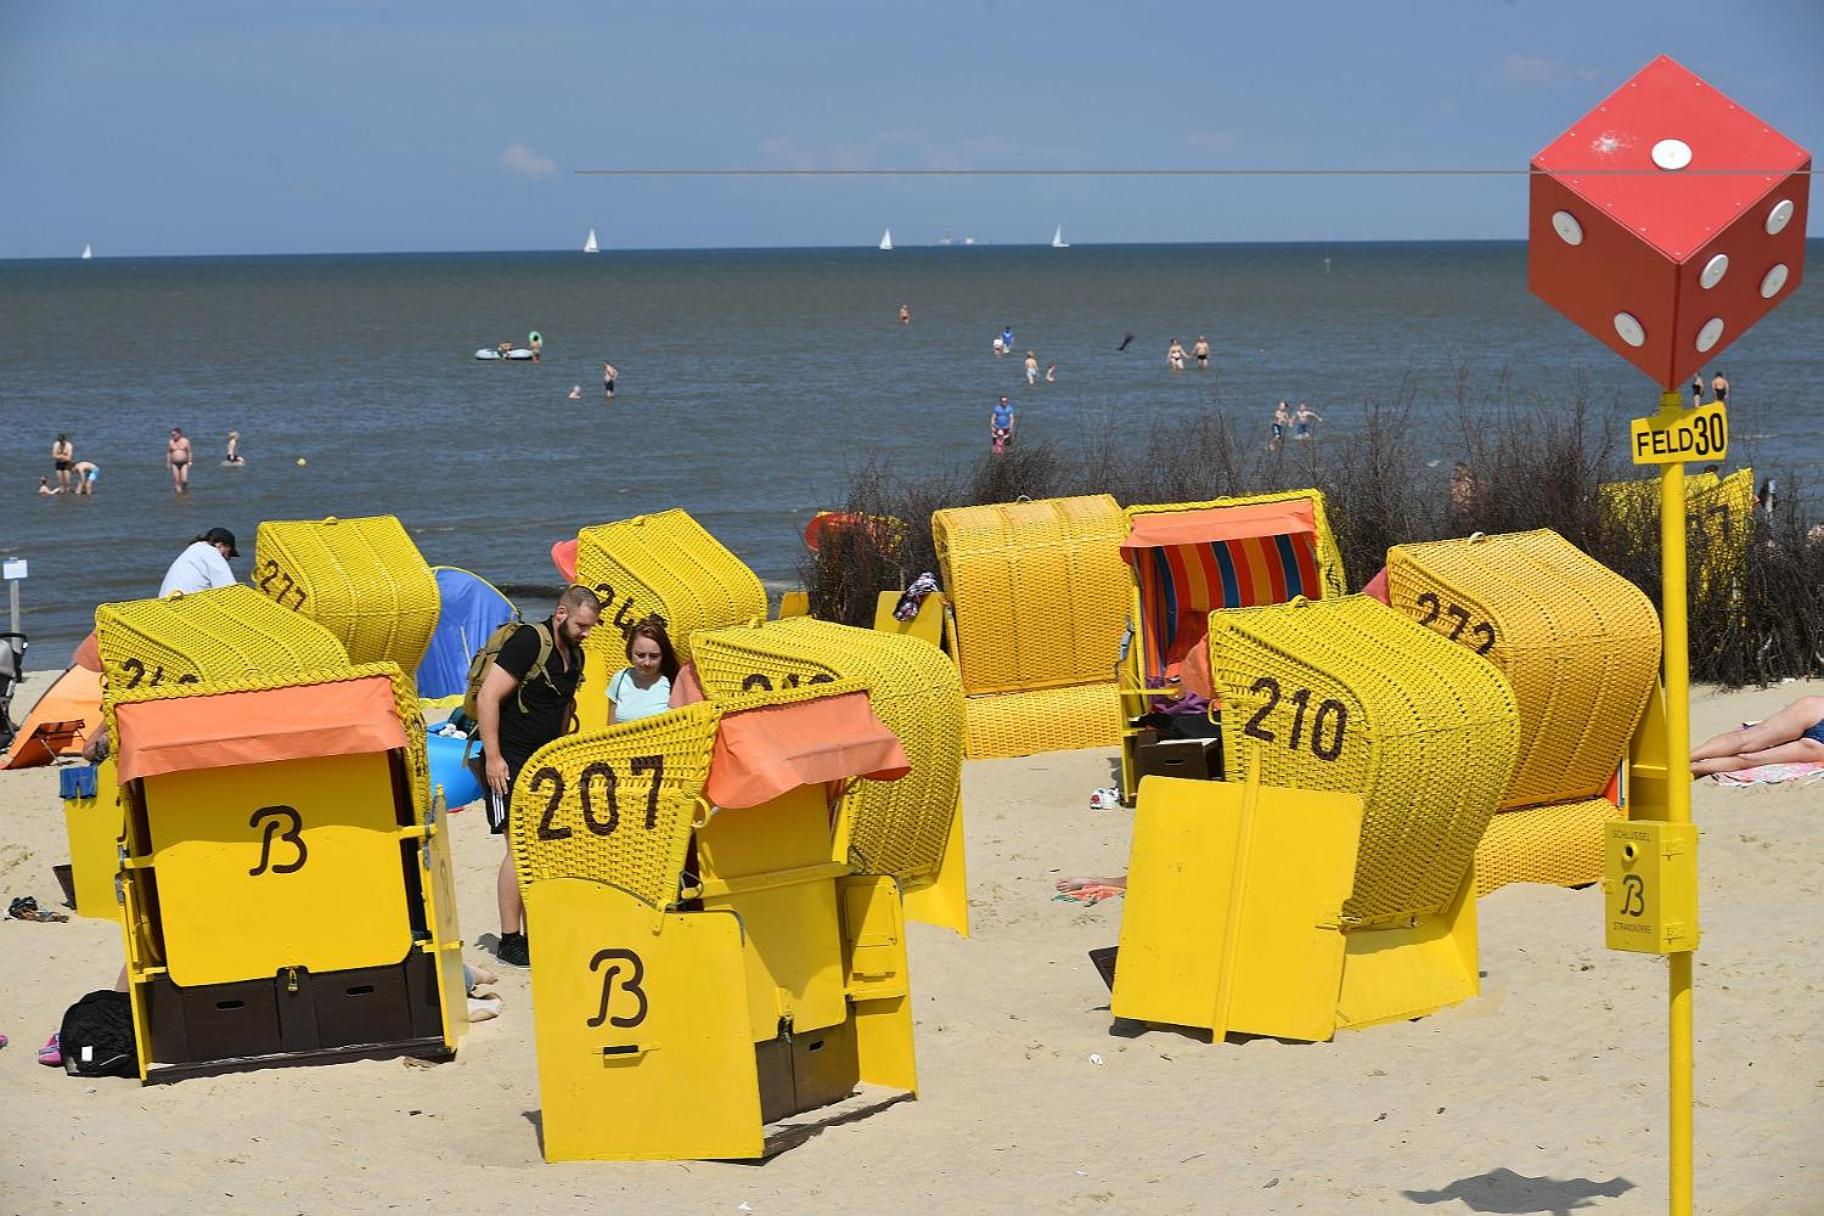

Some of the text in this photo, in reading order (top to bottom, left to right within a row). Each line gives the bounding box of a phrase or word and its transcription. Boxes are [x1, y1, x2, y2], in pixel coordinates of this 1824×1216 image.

[260, 560, 307, 612] 277
[1417, 592, 1496, 656] 272
[1244, 676, 1348, 761] 210
[530, 754, 664, 842] 207
